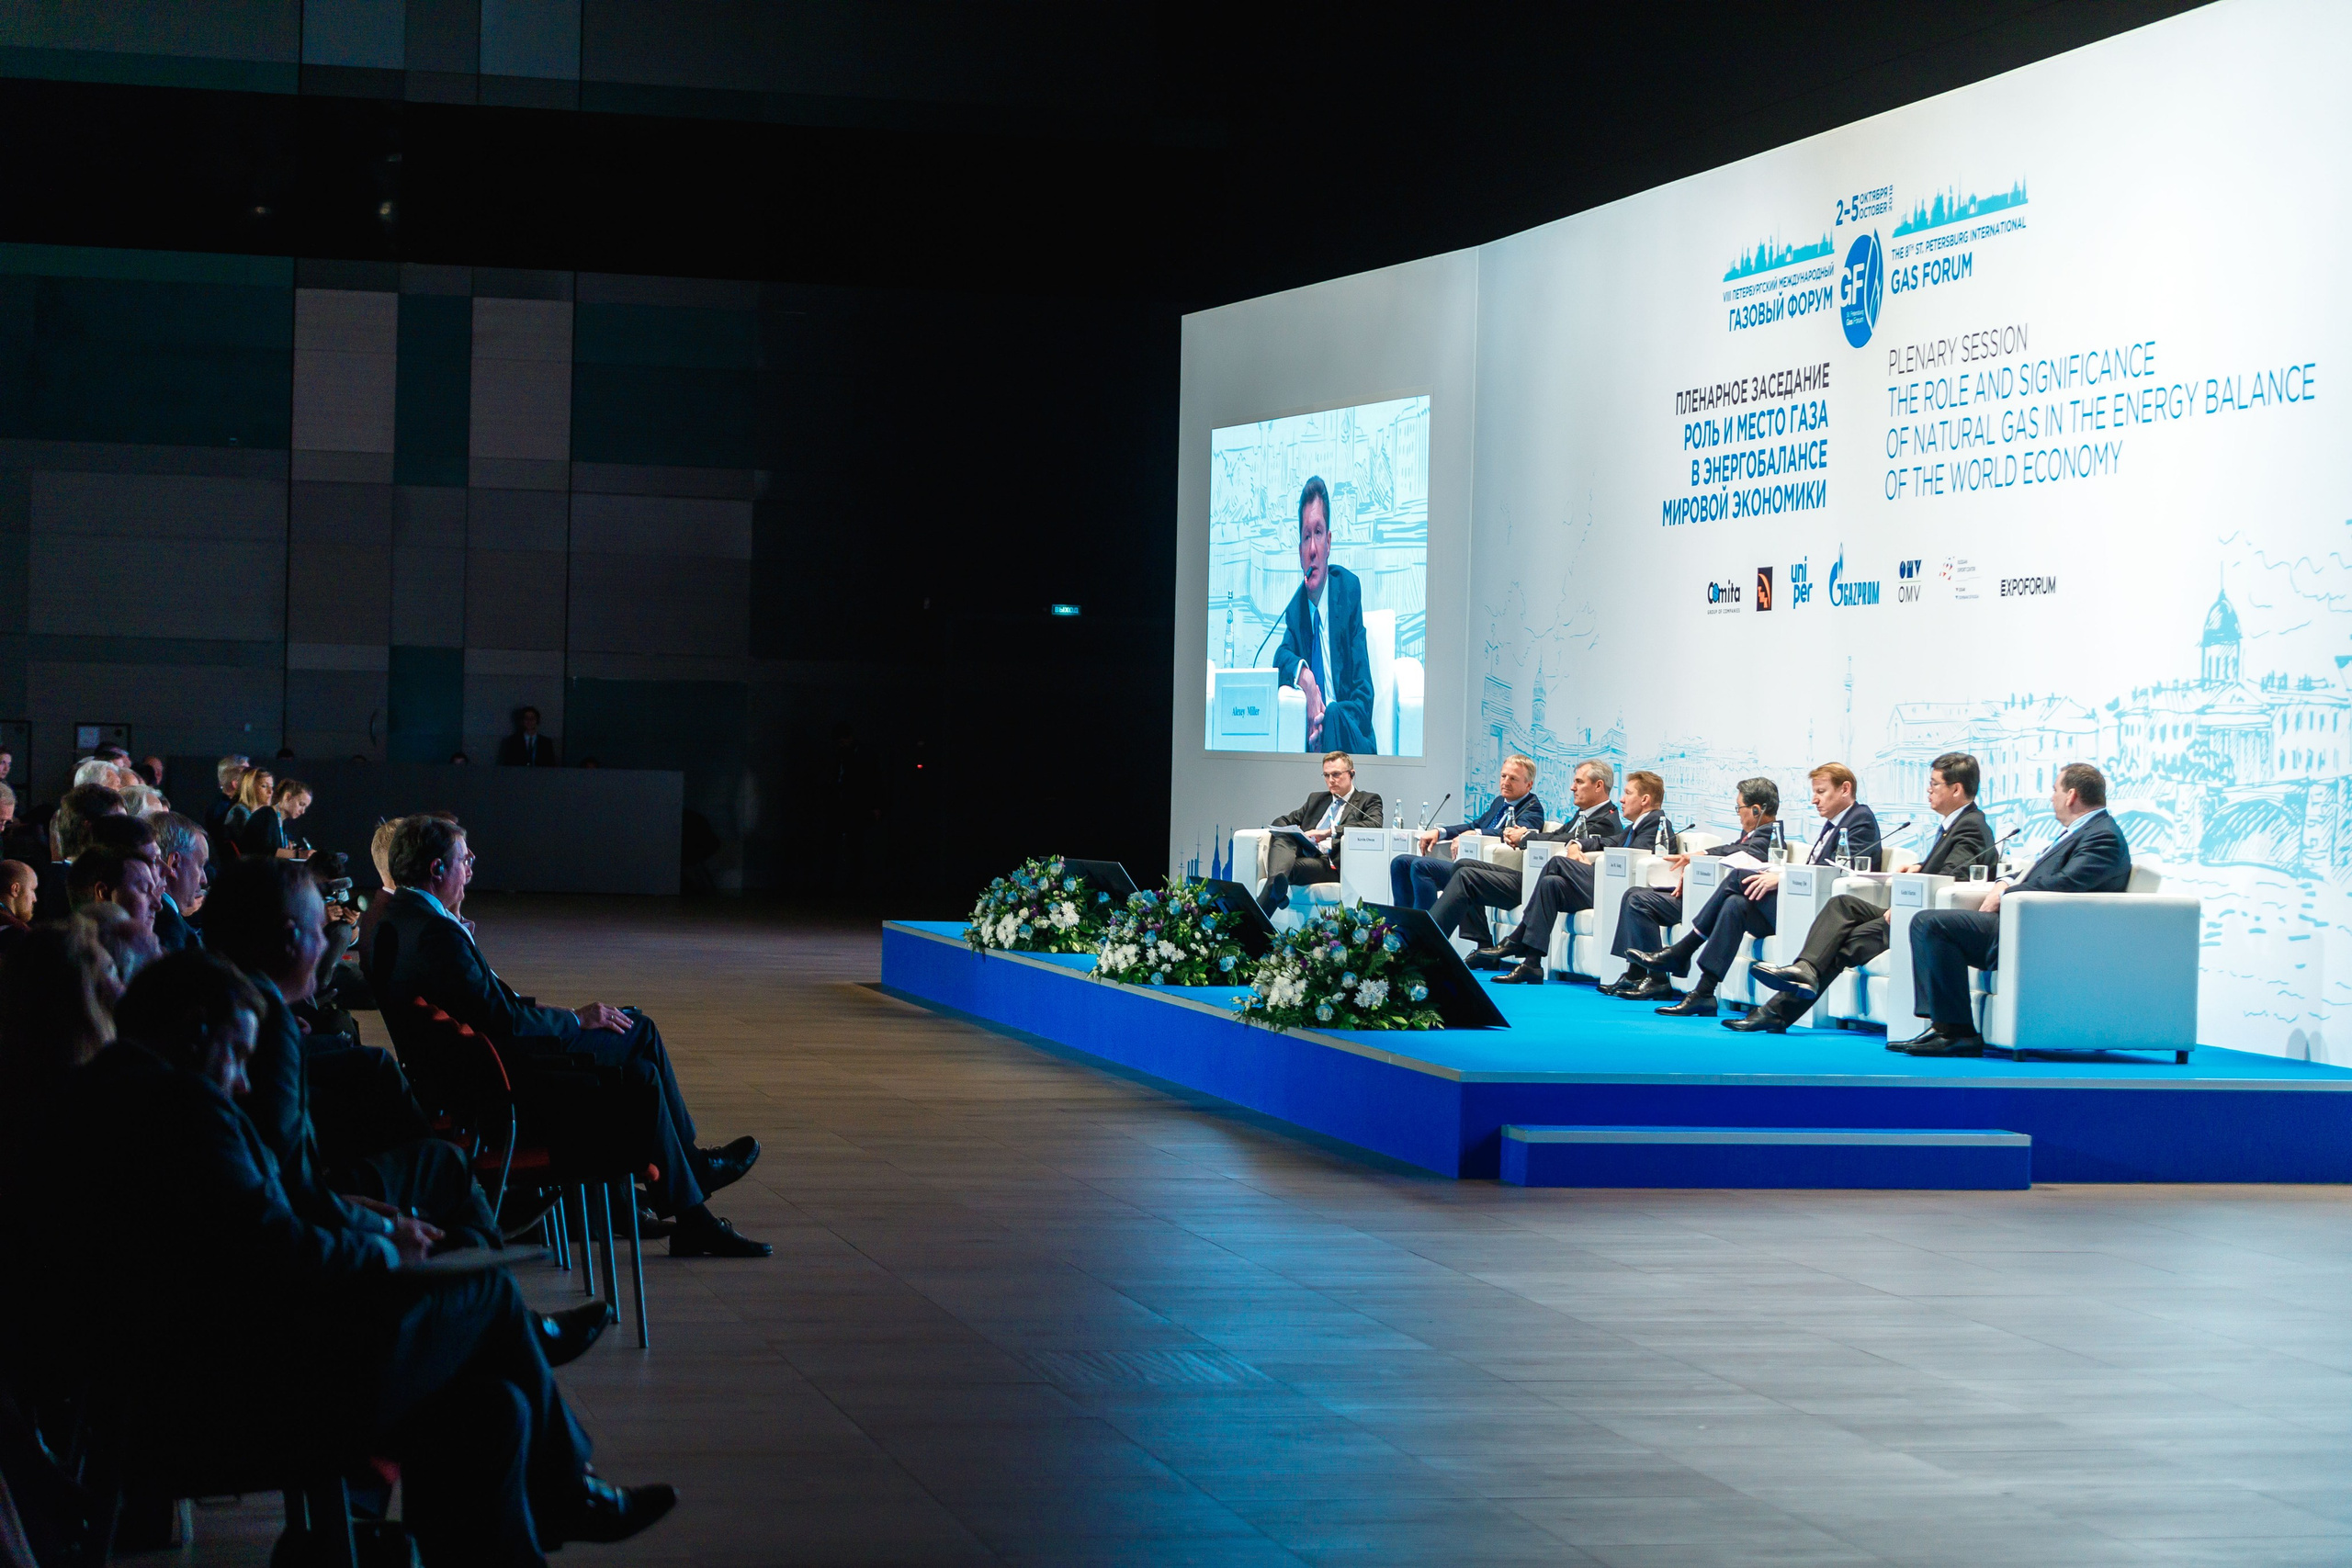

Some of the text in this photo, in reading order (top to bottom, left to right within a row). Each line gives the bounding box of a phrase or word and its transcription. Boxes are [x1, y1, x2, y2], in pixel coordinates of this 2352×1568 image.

[1860, 186, 1888, 205] ОКТЯБРЯ
[1860, 202, 1888, 219] OCTOBER
[1891, 246, 1904, 261] THE
[1915, 242, 1924, 255] ST.
[1925, 231, 1968, 253] PETERSBURG
[1970, 216, 2026, 242] INTERNATIONAL
[1732, 276, 1777, 300] ПЕТЕРБУРГСКИЙ
[1779, 261, 1834, 288] МЕЖДУНАРОДНЫЙ
[1840, 263, 1865, 307] GF
[1891, 252, 1973, 294] GAS FORUM
[1729, 285, 1833, 332] ГАЗОВЫЙ ФОРУМ
[1888, 323, 2028, 376] PLENARY SESSION
[1675, 362, 1830, 416] ПЛЕНАРНОЕ ЗАСЕДАНИЕ
[1888, 341, 2155, 417] THE ROLE AND SIGNIFICANCE
[1684, 399, 1828, 451] РОЛЬ И МЕСТО ГАЗА
[1886, 363, 2316, 459] OF NATURAL GAS IN THE ENERGY BALANCE
[1691, 439, 1828, 486] В ЭНЕРГОБАЛАНСЕ
[1885, 440, 2123, 501] OF THE WORLD ECONOMY
[1662, 479, 1826, 527] МИРОВОЙ ЭКОНОМИКИ
[1791, 556, 1807, 583] uni
[1899, 559, 1922, 579] OMV
[2001, 575, 2056, 597] EXPOFORUM
[1793, 583, 1813, 609] per
[1843, 581, 1880, 606] GAZPROM
[1898, 585, 1921, 603] OMV
